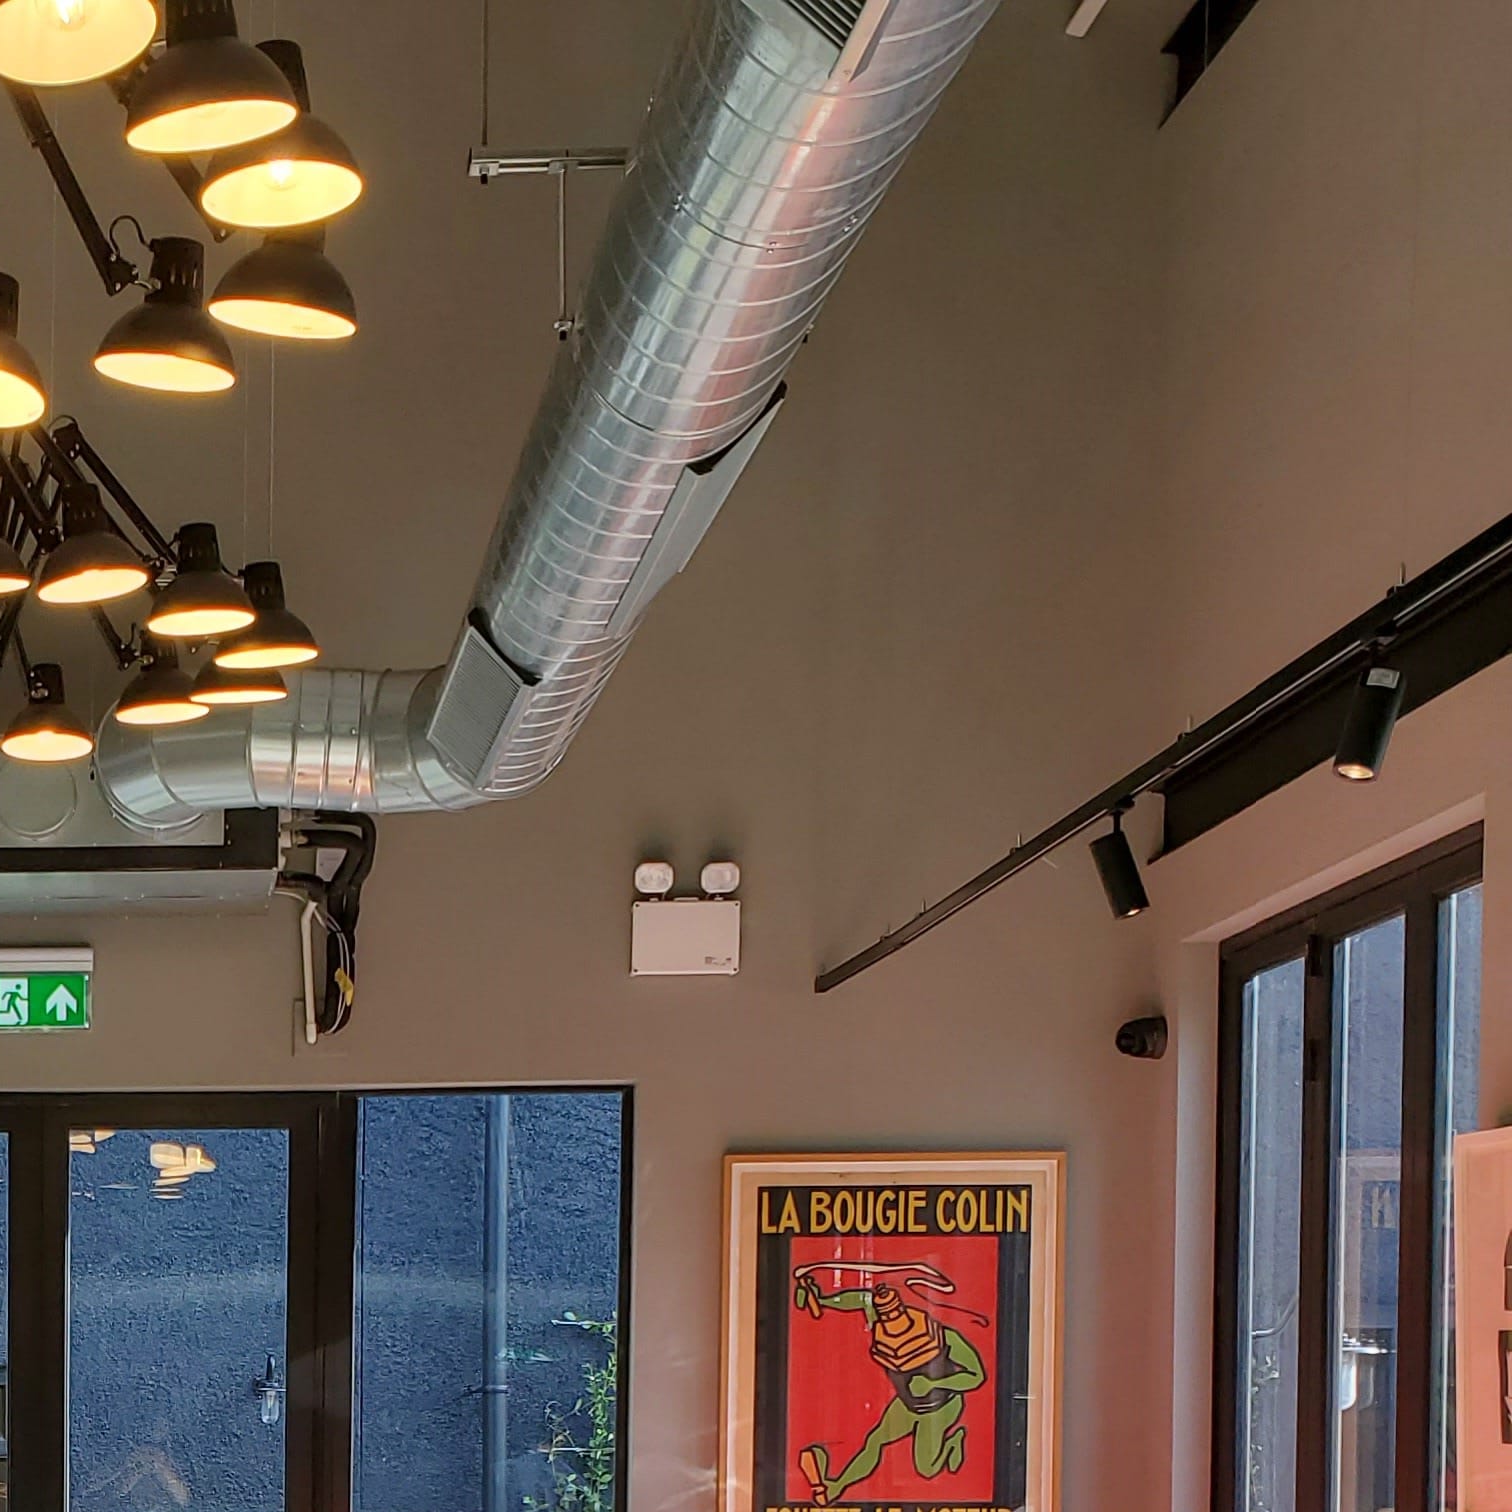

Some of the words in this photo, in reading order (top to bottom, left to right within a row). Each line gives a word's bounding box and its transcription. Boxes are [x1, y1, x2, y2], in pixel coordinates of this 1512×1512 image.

[761, 1190, 801, 1234] LA
[810, 1190, 927, 1234] BOUGIE
[936, 1189, 1028, 1233] COLIN
